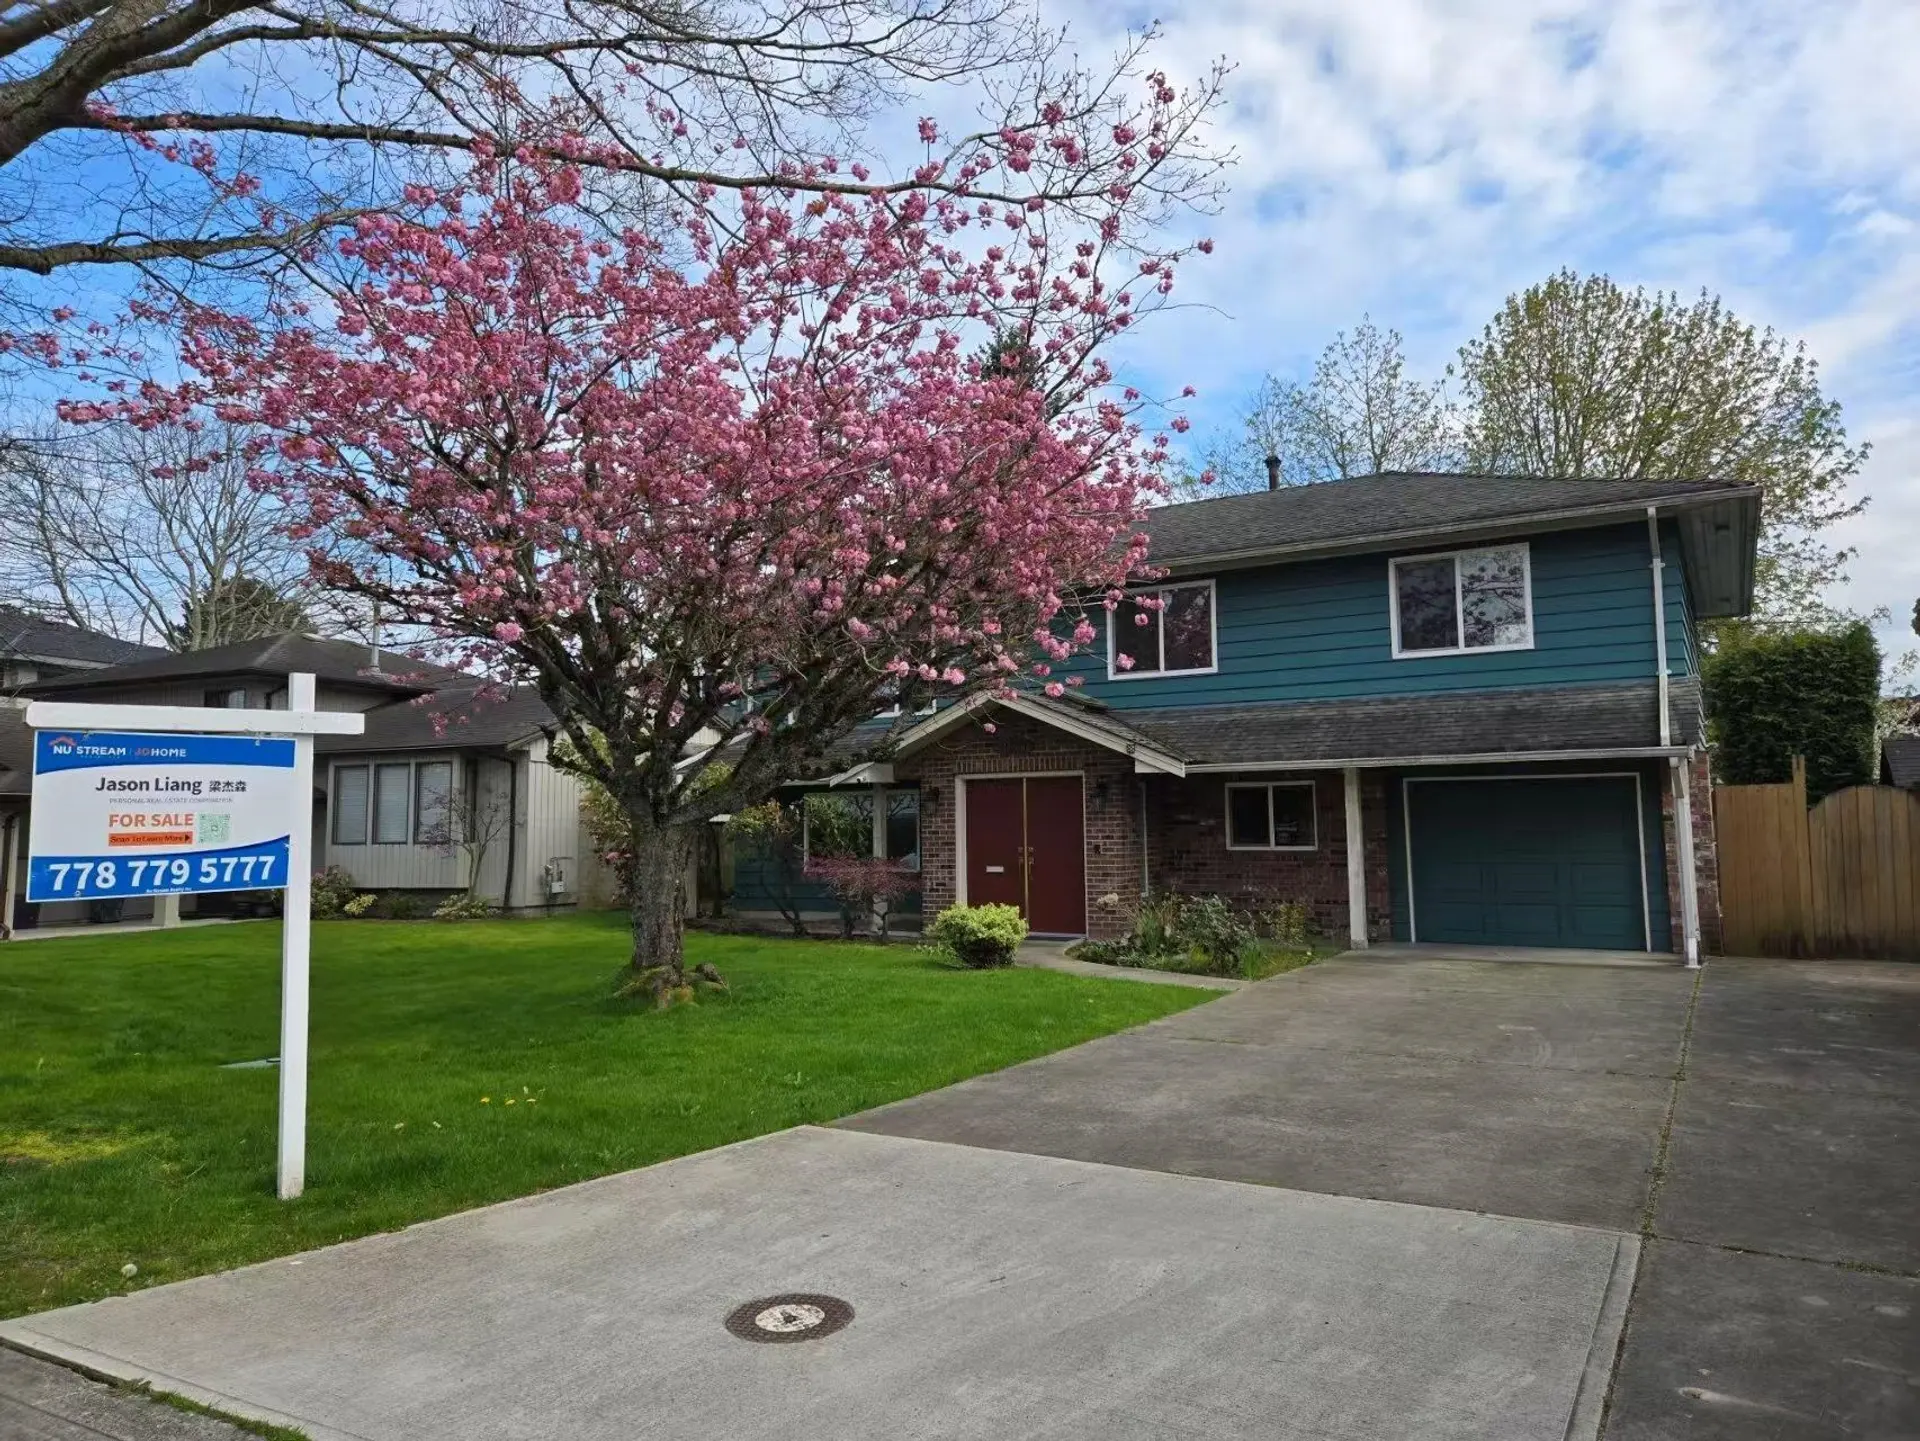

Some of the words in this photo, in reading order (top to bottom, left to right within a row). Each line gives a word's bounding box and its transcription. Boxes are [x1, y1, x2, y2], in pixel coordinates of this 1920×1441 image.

[53, 745, 72, 755] NU
[76, 746, 126, 756] STREAM
[95, 776, 150, 792] Jason
[154, 776, 203, 796] Liang
[208, 779, 248, 793] 梁杰森
[108, 813, 146, 828] FOR
[150, 813, 195, 827] SALE
[49, 861, 116, 891] 778
[127, 858, 191, 887] 779
[199, 855, 276, 884] 5777
